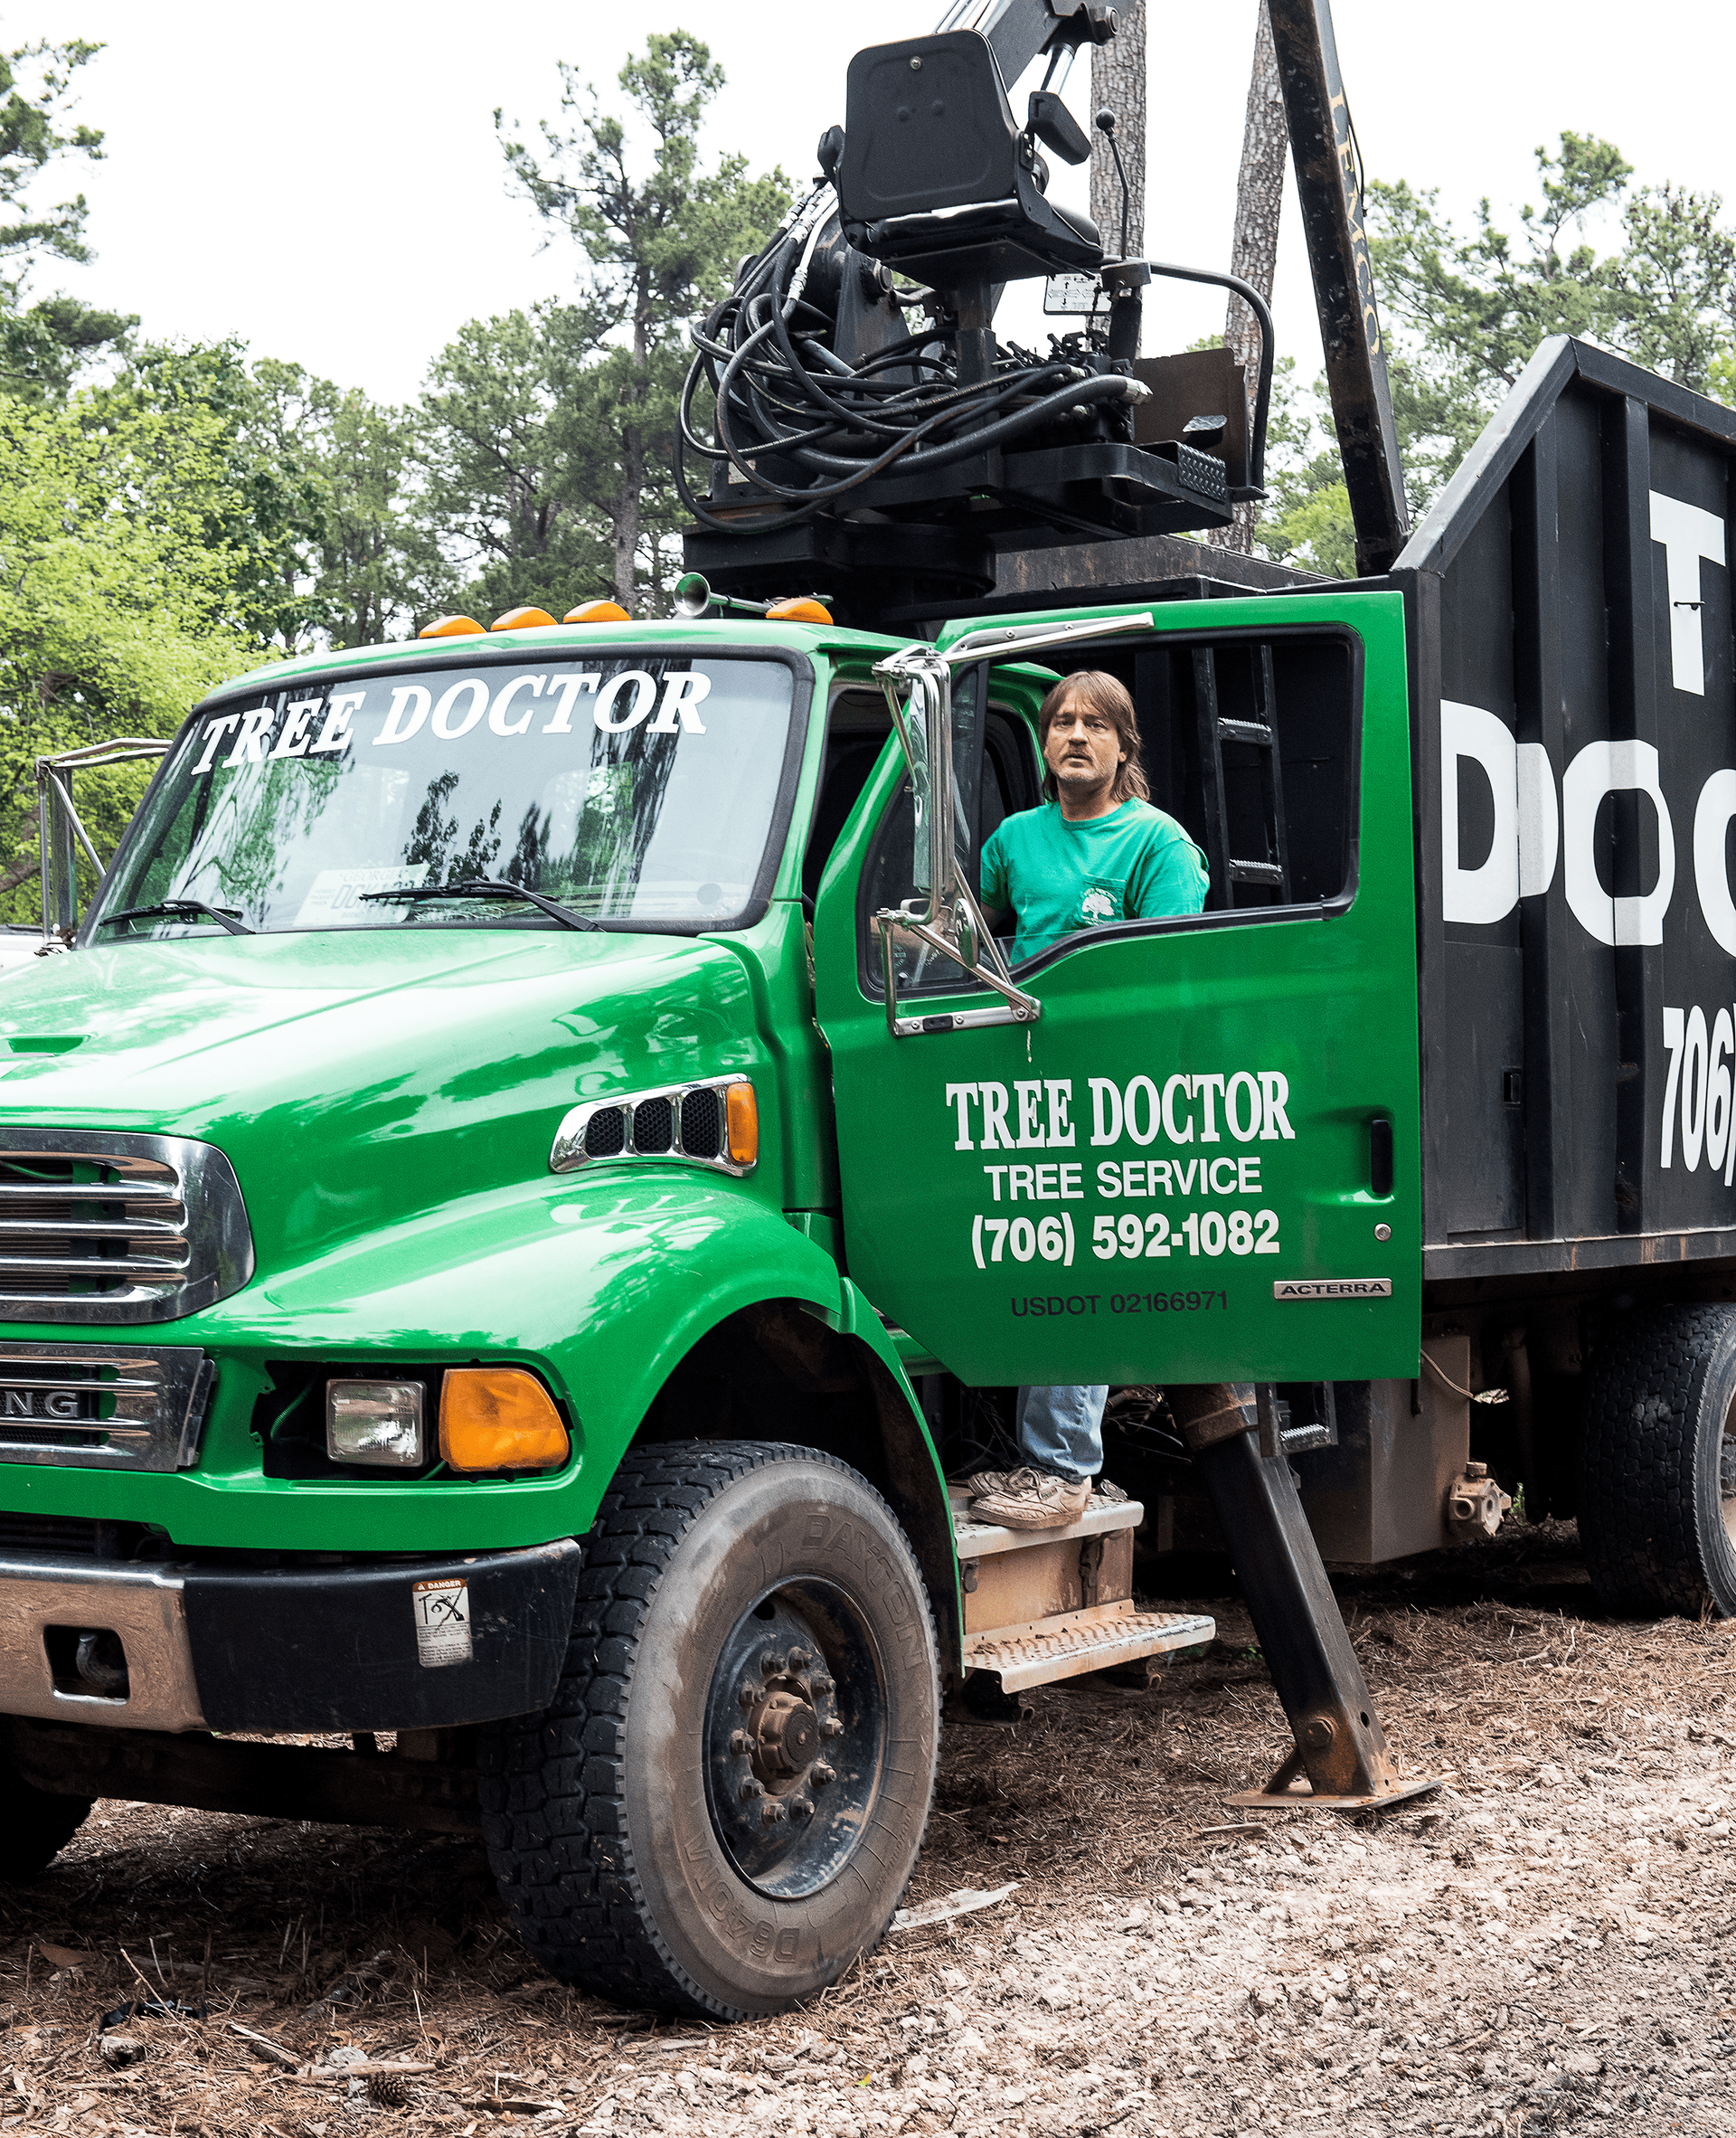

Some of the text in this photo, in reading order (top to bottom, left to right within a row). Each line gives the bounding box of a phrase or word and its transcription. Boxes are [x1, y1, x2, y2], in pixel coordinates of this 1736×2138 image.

[190, 670, 712, 776] TREE DOCTOR
[945, 1071, 1296, 1151] TREE DOCTOR
[983, 1156, 1263, 1202] TREE SERVICE
[971, 1208, 1280, 1269] (706) 592-1082
[1010, 1290, 1229, 1318] USDOT 02166971
[1280, 1282, 1387, 1296] ACTERRA
[427, 1580, 462, 1590] DANGER
[800, 1511, 925, 1671] DAYTON
[684, 1831, 800, 1963] D640M
